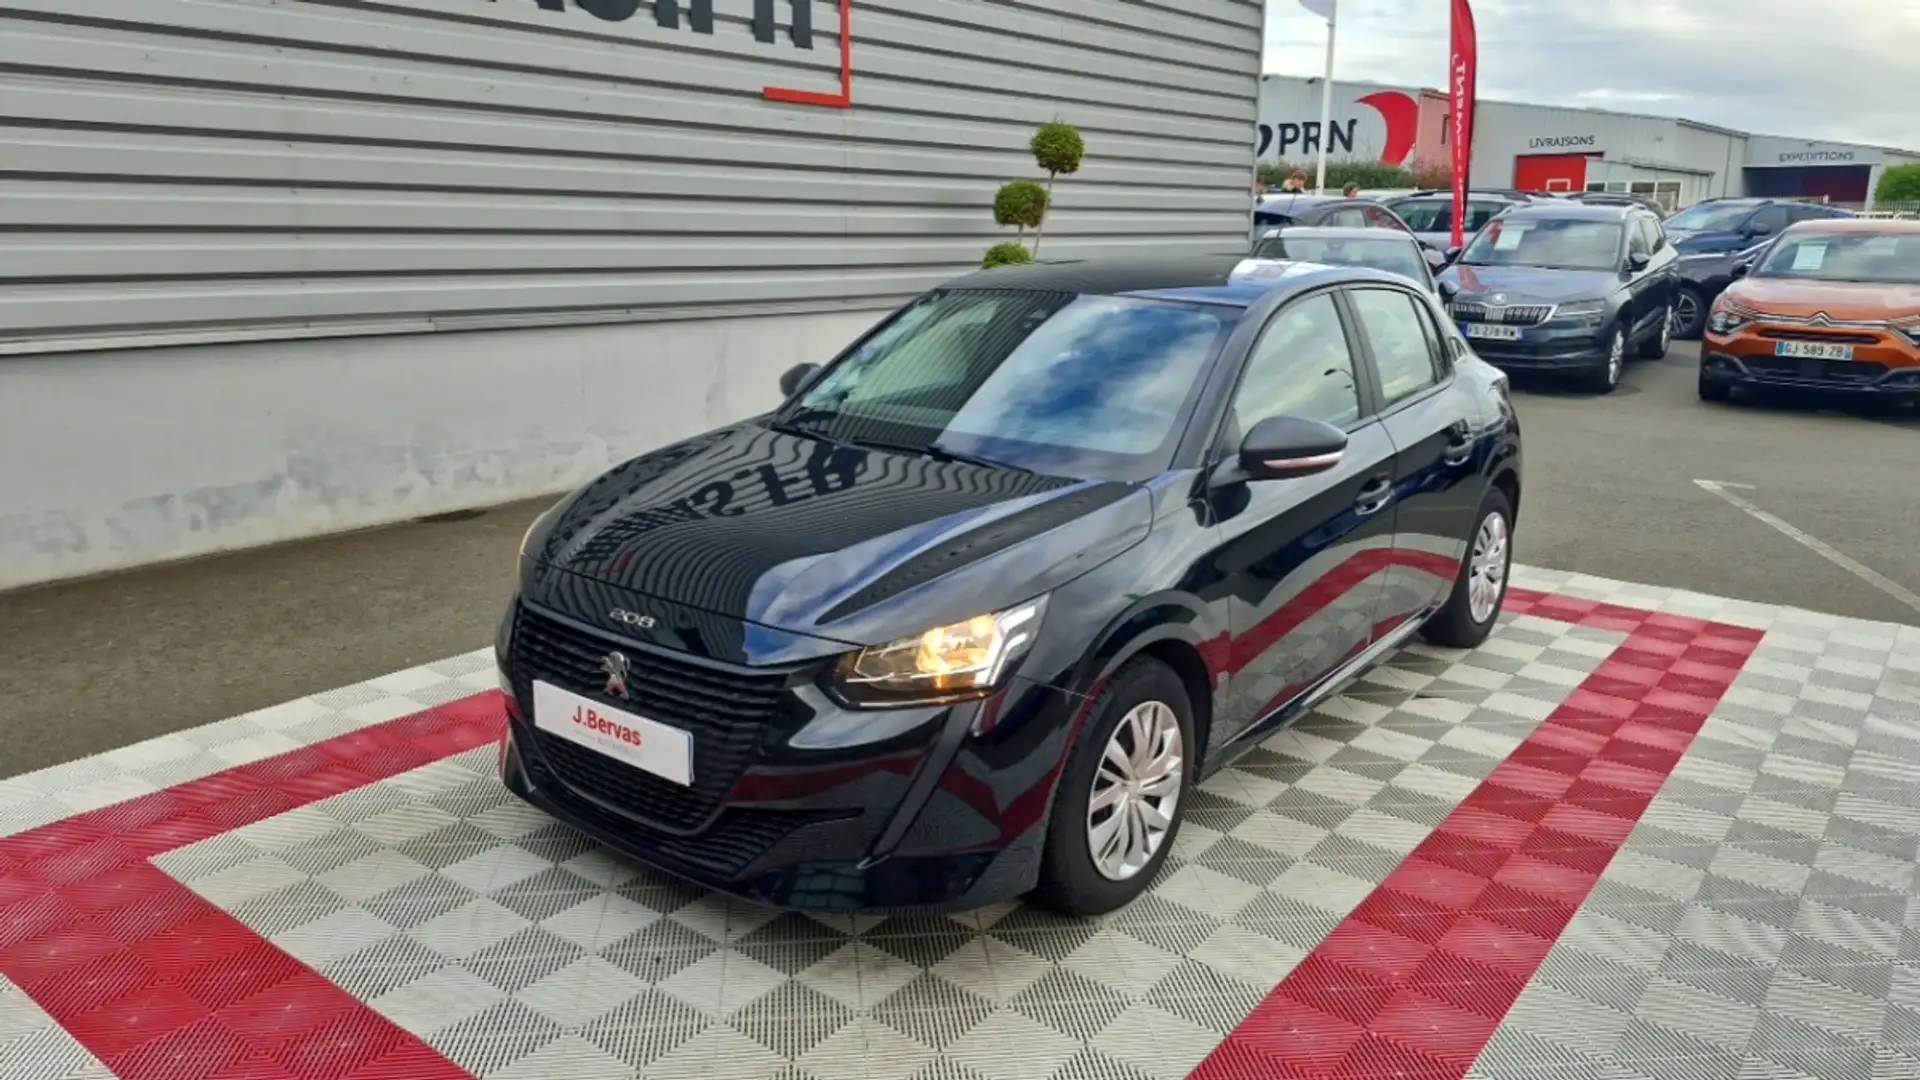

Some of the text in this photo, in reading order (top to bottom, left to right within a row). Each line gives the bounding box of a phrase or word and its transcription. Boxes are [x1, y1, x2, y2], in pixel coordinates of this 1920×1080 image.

[1278, 118, 1358, 156] PRN
[1528, 134, 1596, 149] LIVRAISONS
[609, 607, 656, 629] 208
[573, 705, 642, 746] J.Bervas
